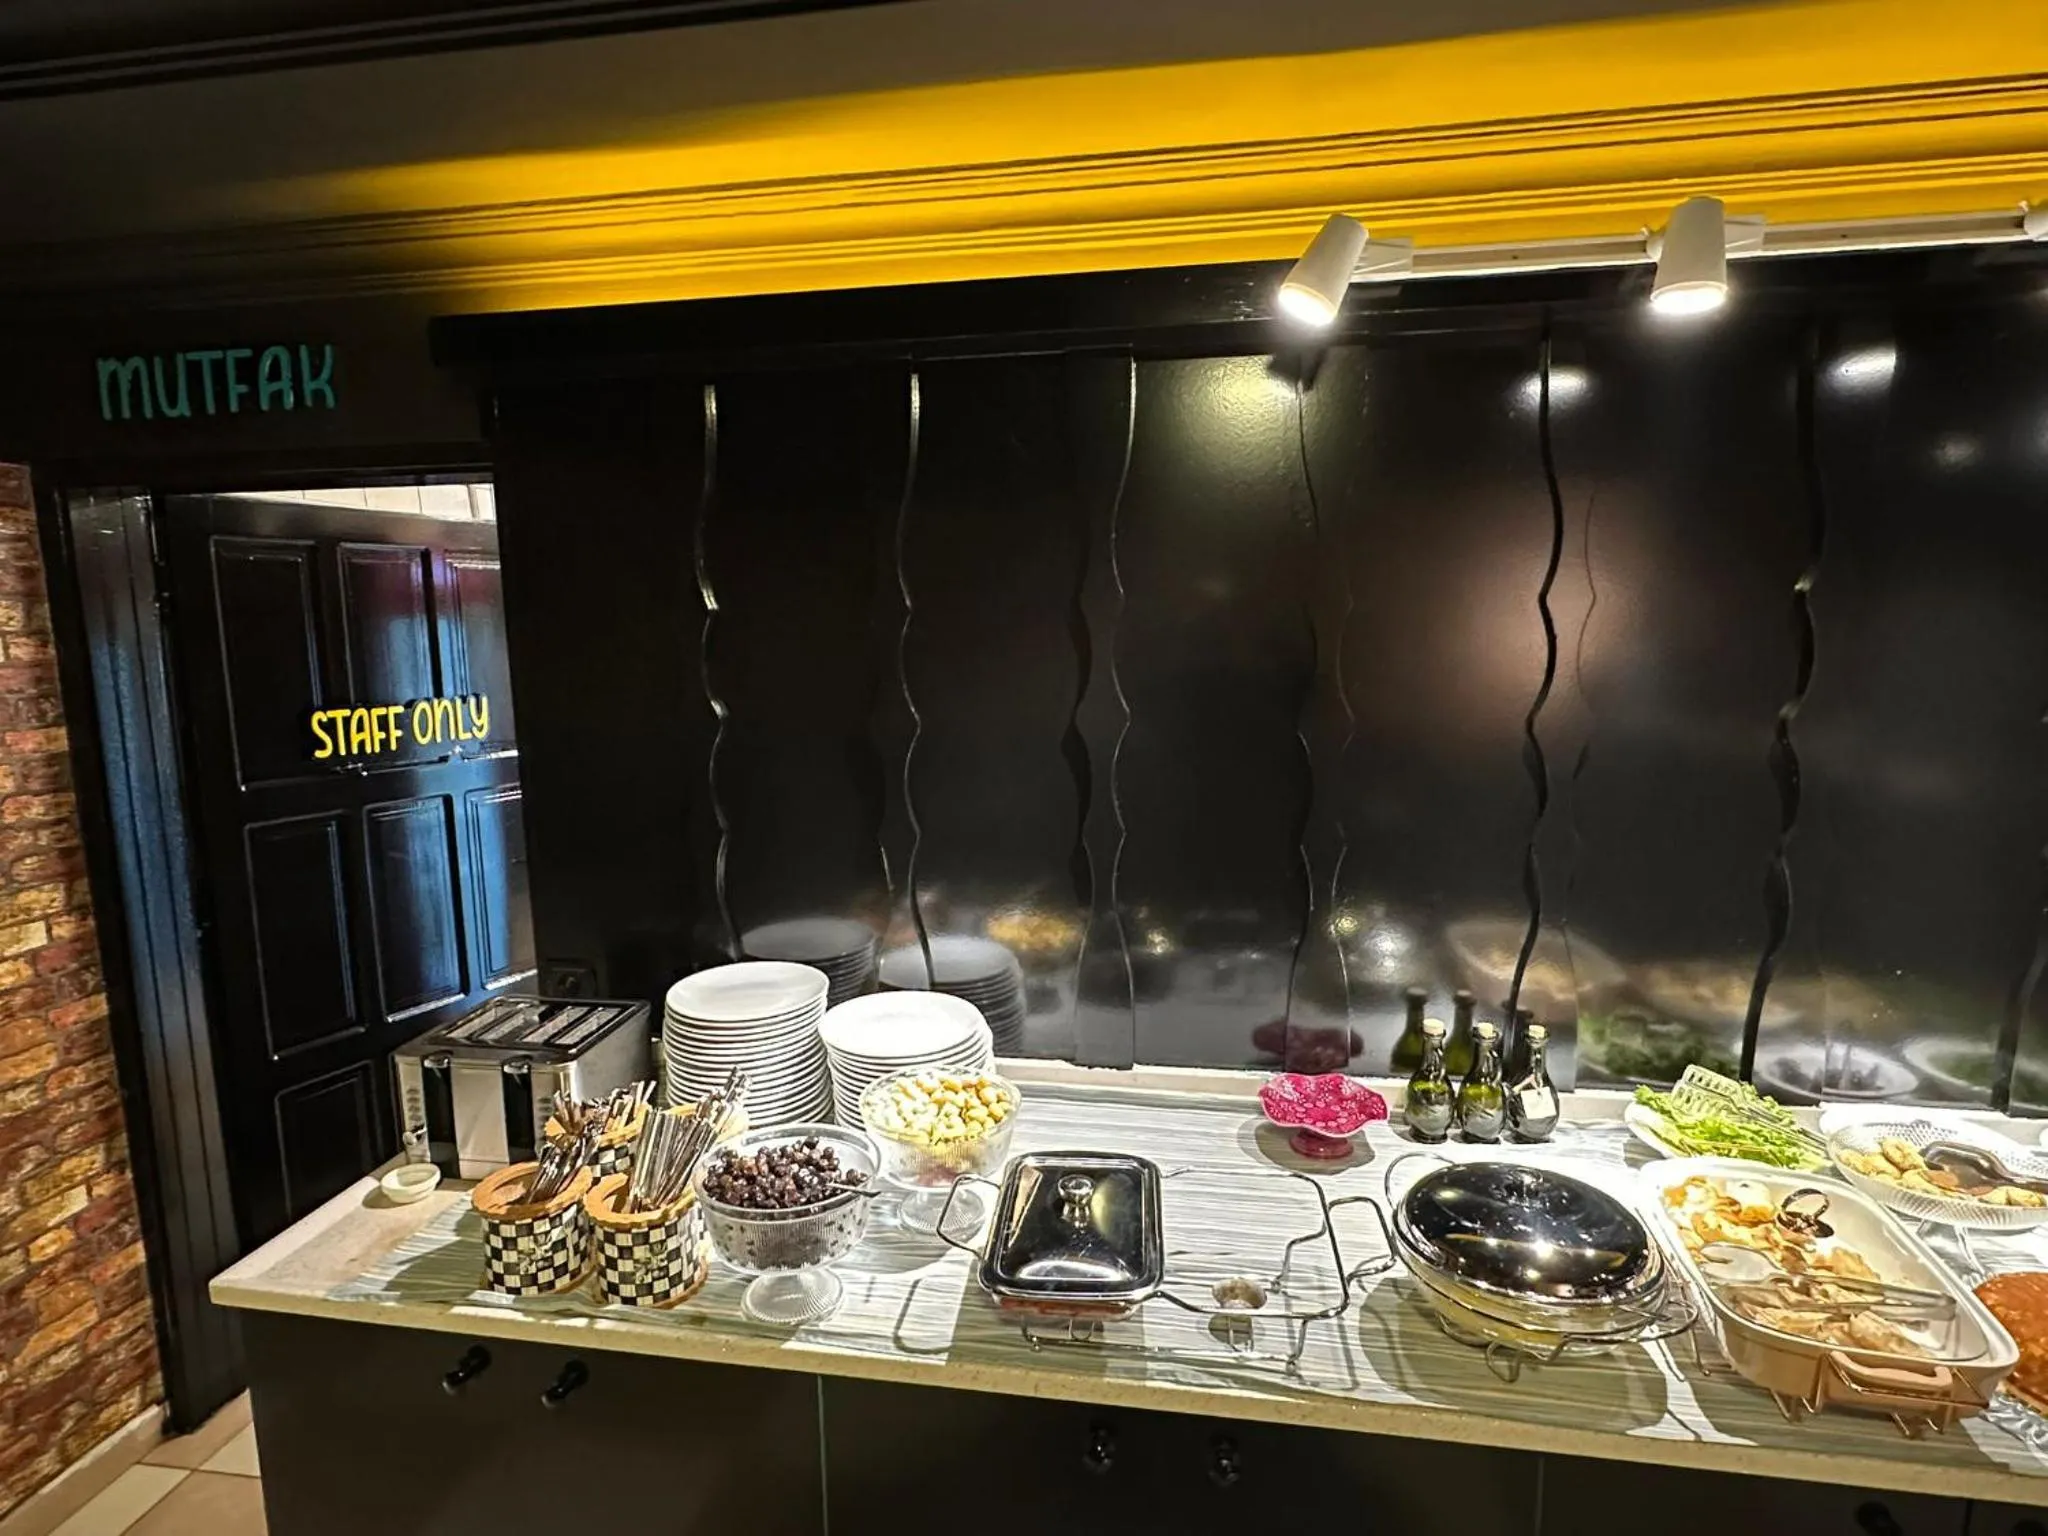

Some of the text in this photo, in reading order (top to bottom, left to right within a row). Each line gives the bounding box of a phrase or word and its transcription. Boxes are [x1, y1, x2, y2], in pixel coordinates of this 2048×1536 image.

[97, 344, 336, 421] MUTFAK
[311, 694, 489, 758] STAFF ONLY
